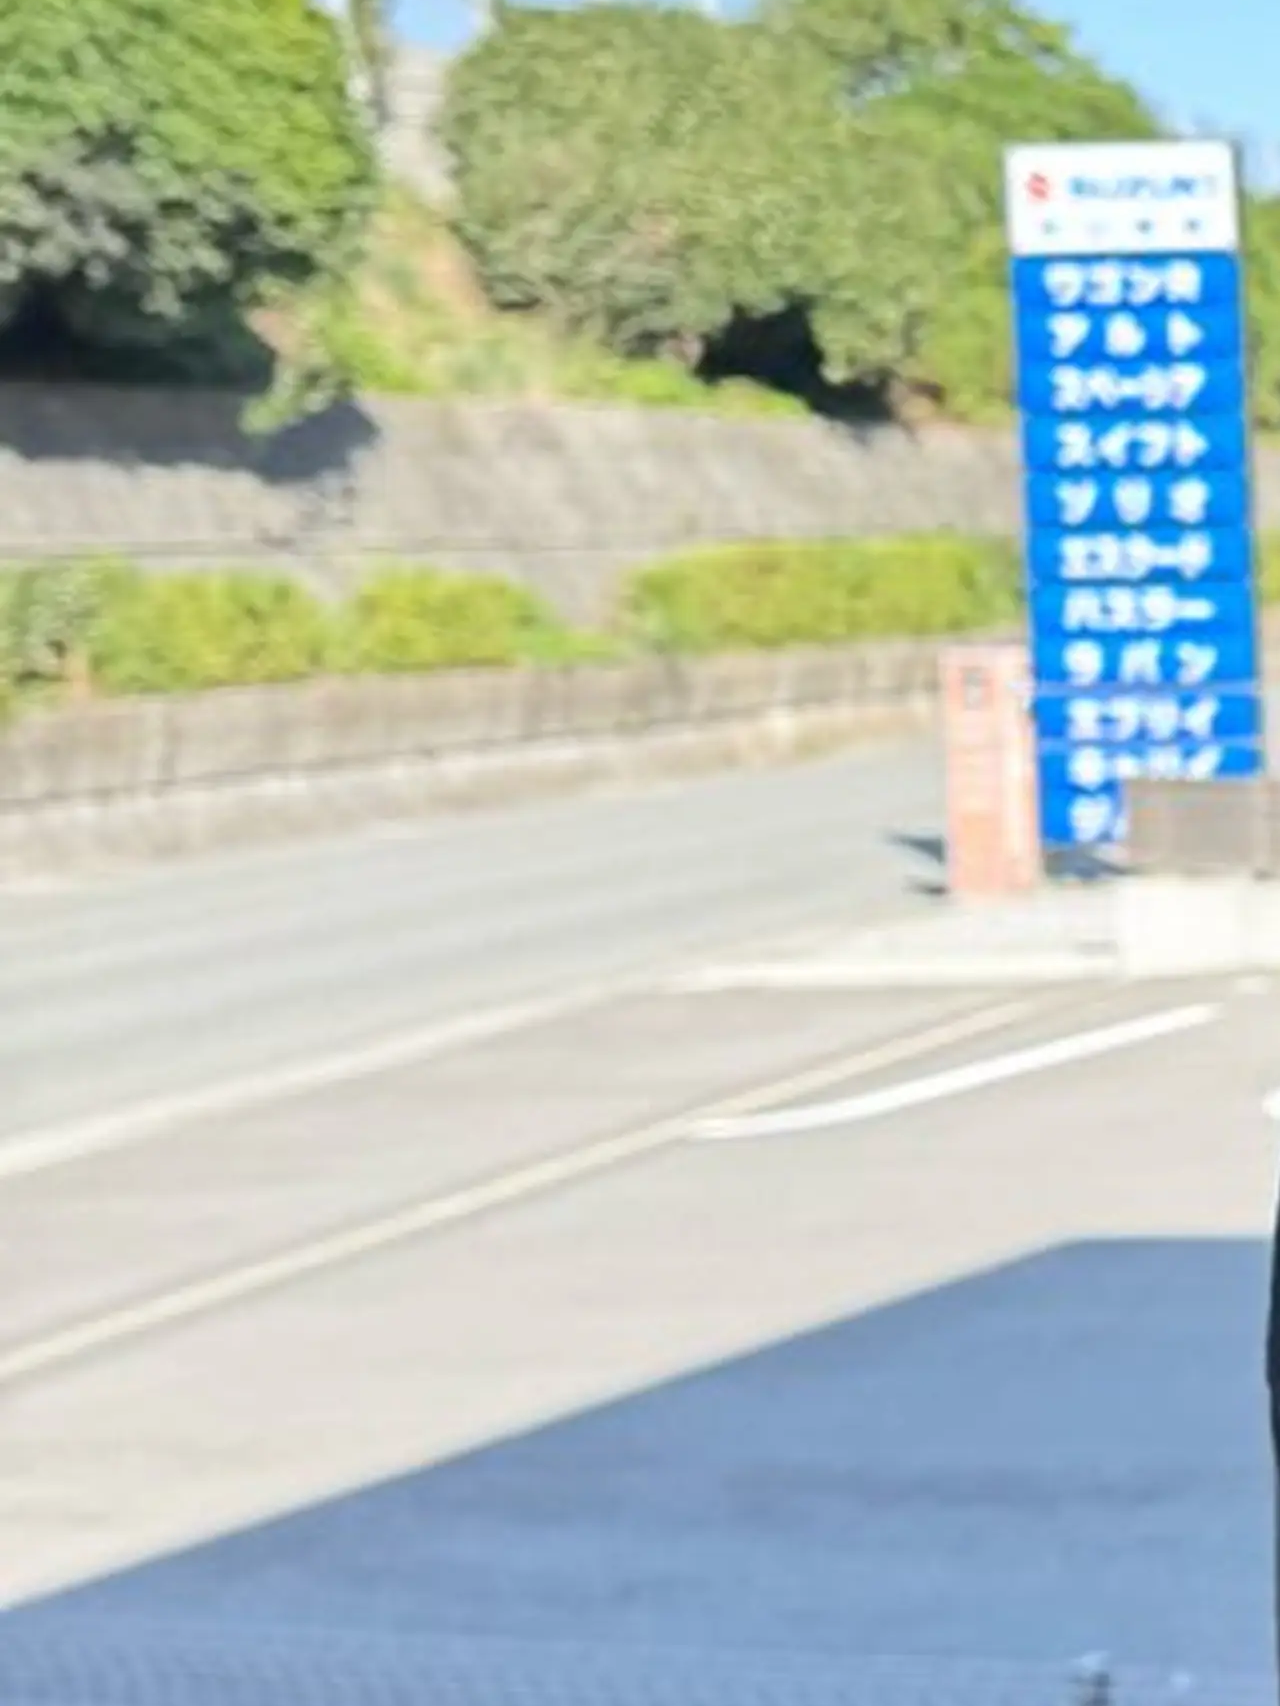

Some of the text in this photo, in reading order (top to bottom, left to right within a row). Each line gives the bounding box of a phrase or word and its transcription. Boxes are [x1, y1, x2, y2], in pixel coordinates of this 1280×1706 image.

[1047, 309, 1205, 358] アルト
[1054, 421, 1210, 468] スイフト
[1055, 476, 1212, 526] ソリオ
[1062, 585, 1217, 633] ハスラー
[1061, 639, 1220, 687] ラパン
